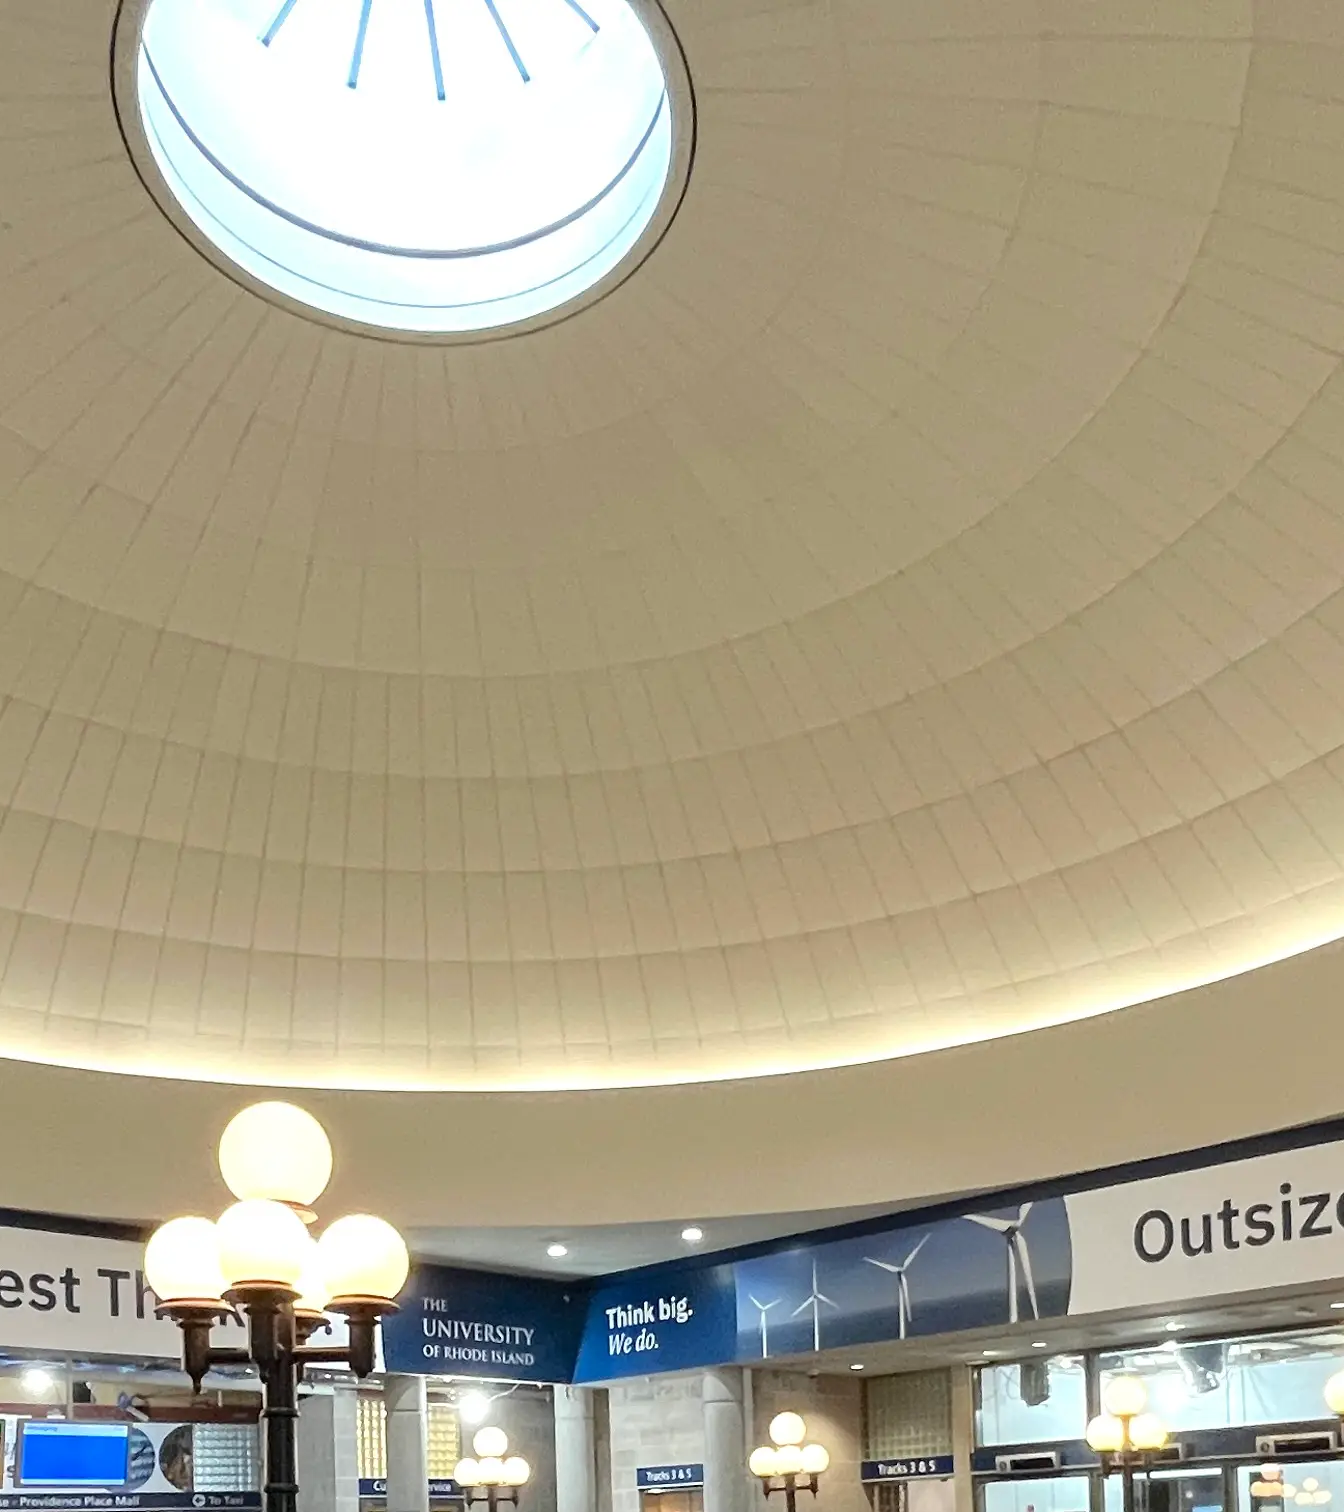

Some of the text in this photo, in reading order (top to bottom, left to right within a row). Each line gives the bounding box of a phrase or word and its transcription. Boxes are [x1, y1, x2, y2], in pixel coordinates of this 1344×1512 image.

[422, 1297, 448, 1312] THE
[606, 1296, 693, 1330] Think big.
[422, 1318, 535, 1347] UNIVERSITY
[608, 1328, 659, 1356] We do.
[423, 1343, 535, 1367] OF RHODE ISLAND
[877, 1462, 908, 1475] Tracks
[19, 1496, 81, 1507] Providence
[84, 1496, 113, 1507] Place
[115, 1495, 140, 1507] Mall
